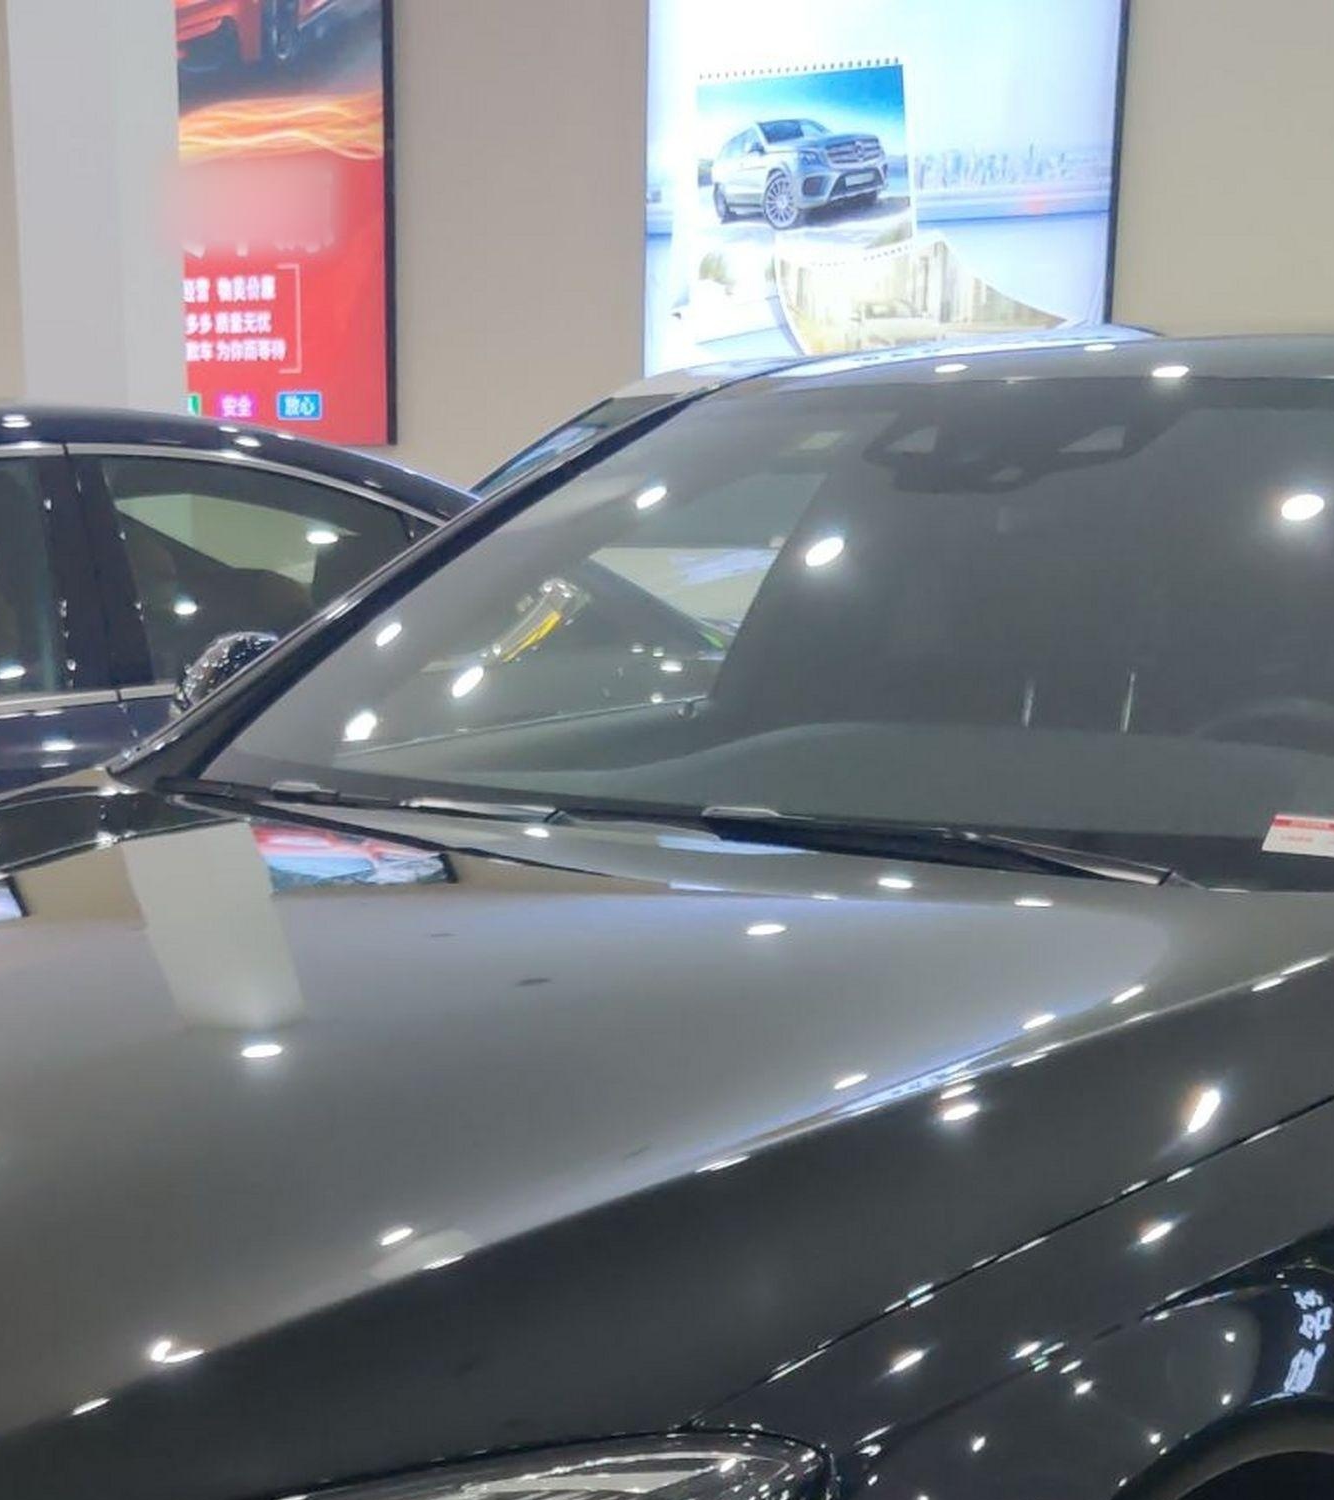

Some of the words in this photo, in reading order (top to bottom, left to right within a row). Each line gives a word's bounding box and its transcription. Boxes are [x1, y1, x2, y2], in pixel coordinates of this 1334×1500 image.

[217, 274, 276, 302] 物美价廉
[221, 395, 253, 417] 安全
[284, 395, 315, 416] 放心
